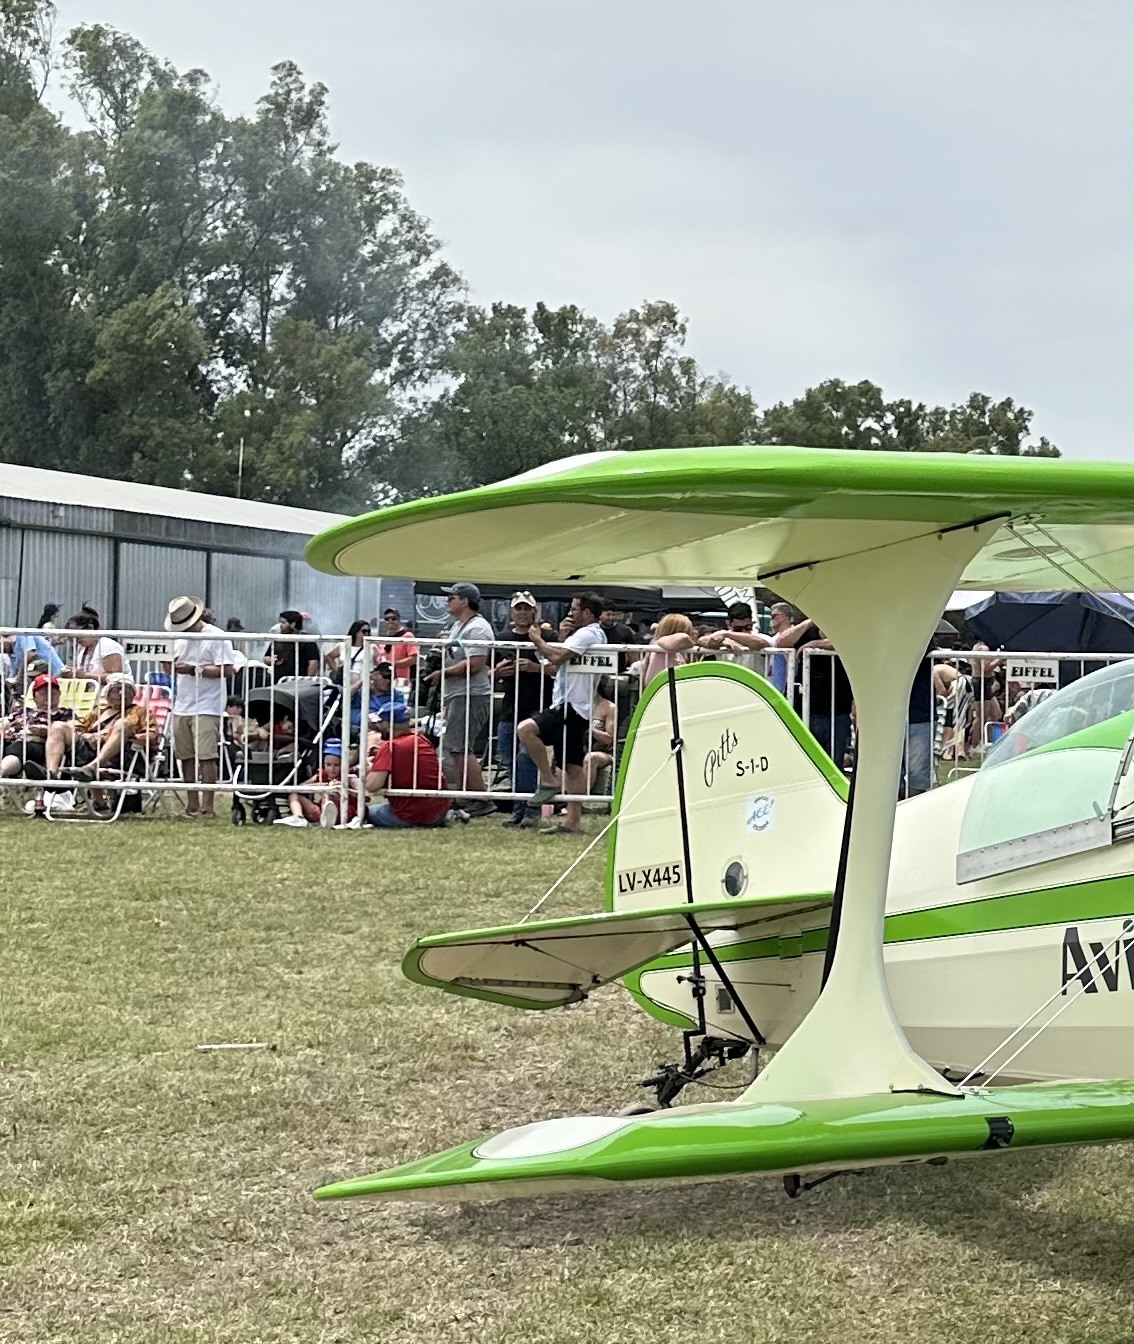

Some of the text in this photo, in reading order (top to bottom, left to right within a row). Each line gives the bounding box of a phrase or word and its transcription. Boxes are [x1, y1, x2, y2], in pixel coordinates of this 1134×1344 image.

[126, 643, 168, 654] EIFFEL
[1011, 666, 1055, 677] EIFFEL
[703, 728, 739, 788] Pitts
[736, 756, 769, 777] S-1-D
[618, 864, 681, 893] LV-X445
